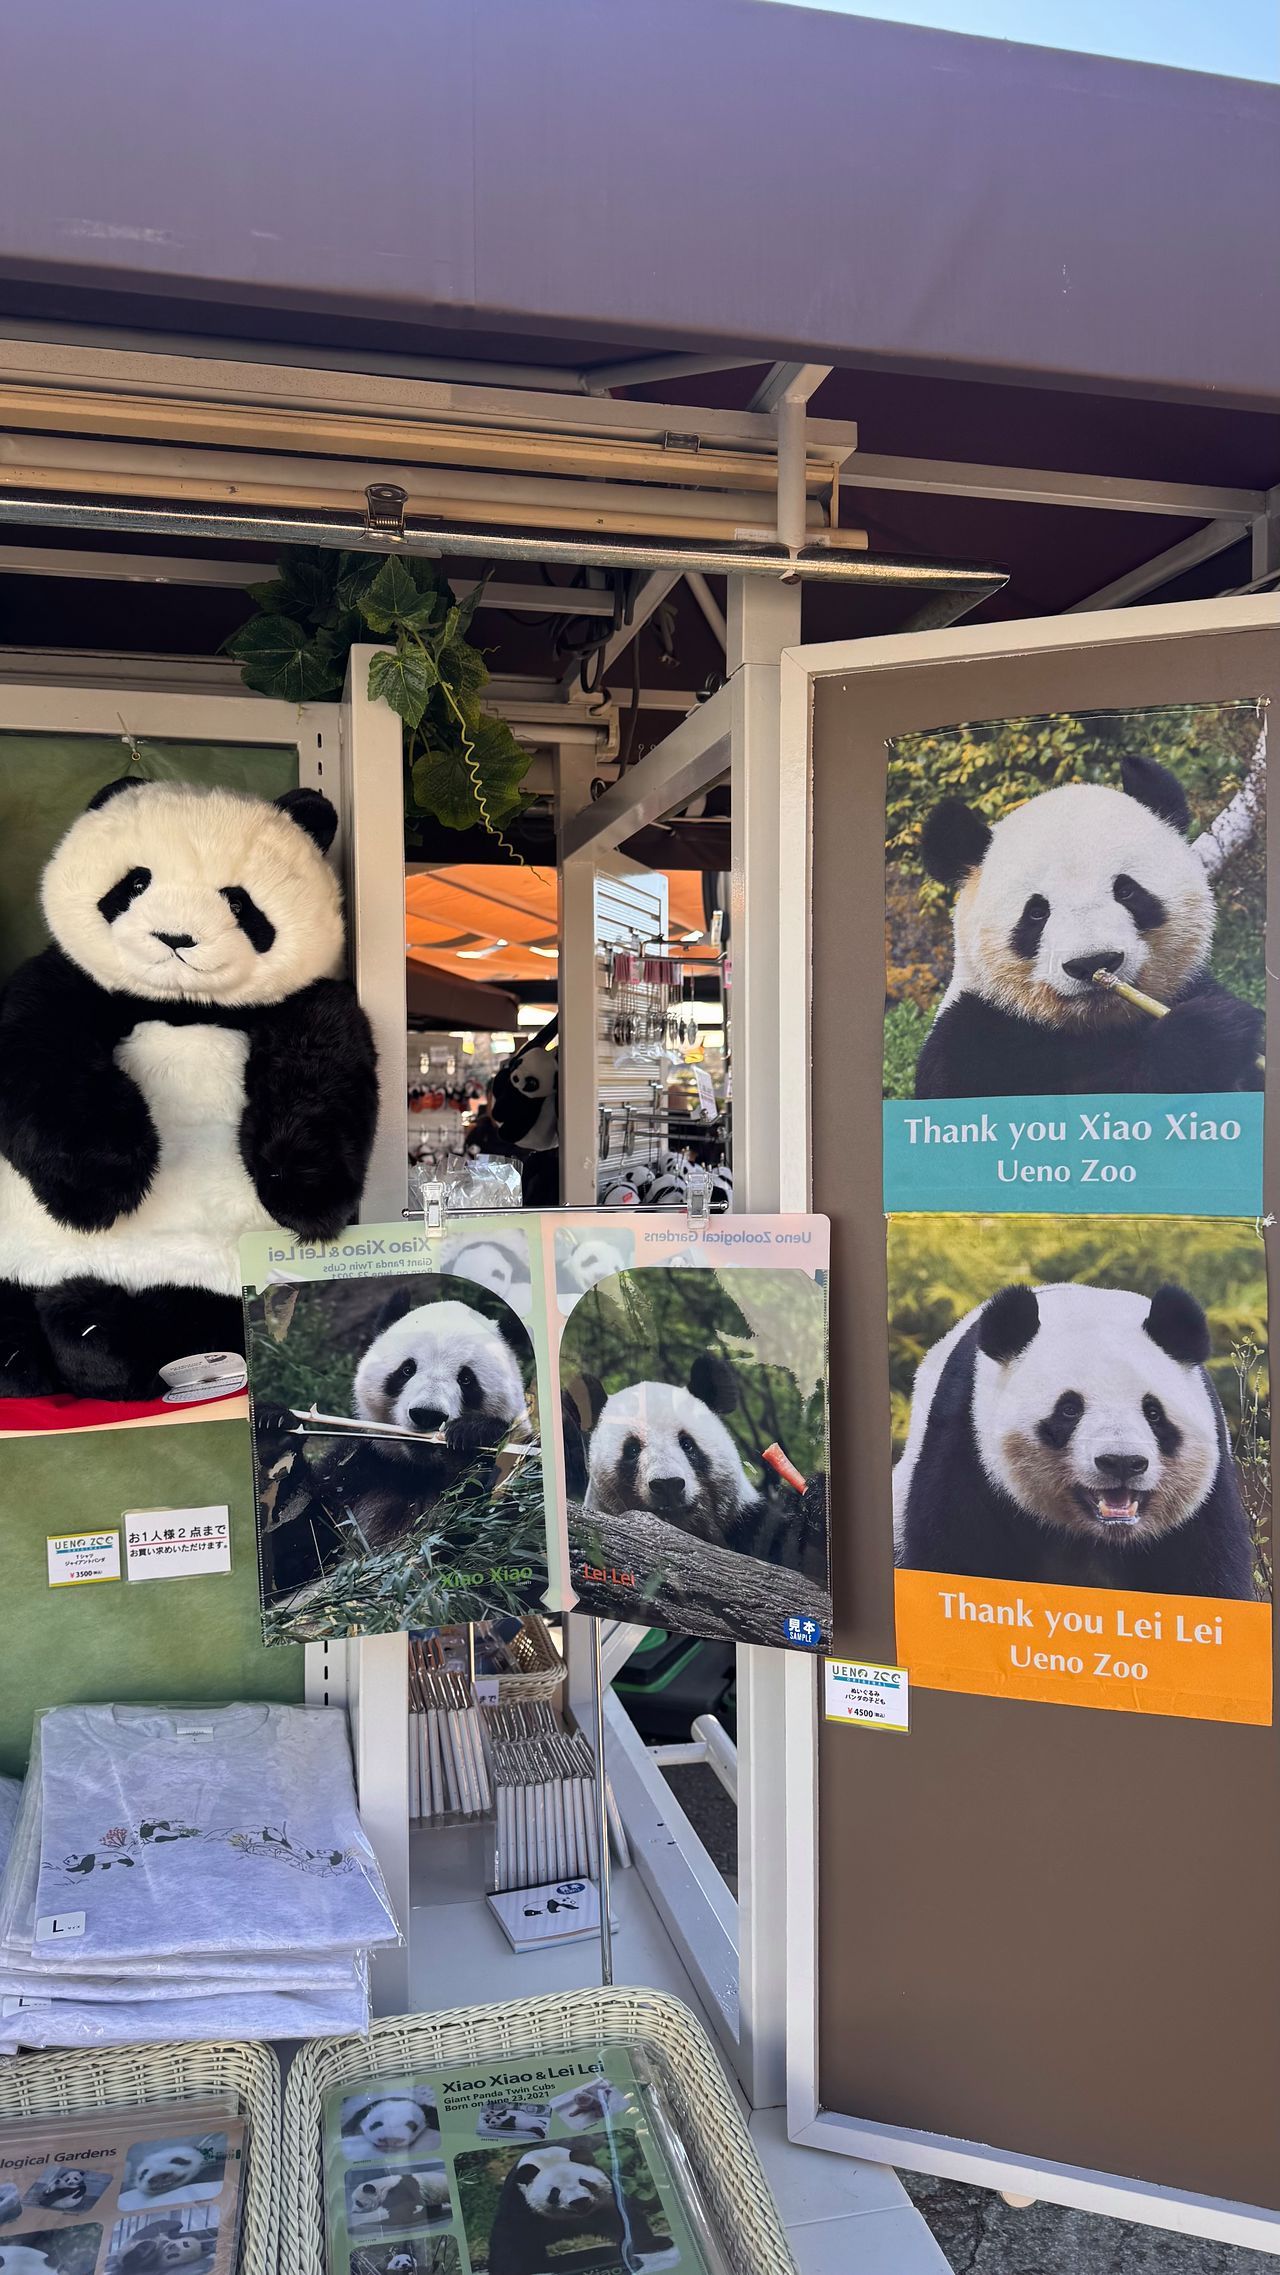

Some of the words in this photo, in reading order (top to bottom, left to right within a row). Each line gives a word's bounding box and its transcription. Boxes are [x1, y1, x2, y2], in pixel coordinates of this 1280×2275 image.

[904, 1114, 998, 1144] Thank
[1008, 1120, 1067, 1151] you
[1079, 1111, 1152, 1142] Xiao
[1164, 1111, 1241, 1142] Xiao
[997, 1159, 1071, 1183] Ueno
[1080, 1159, 1137, 1183] Zoo
[129, 1524, 226, 1543] お1人様2点まで
[55, 1539, 86, 1550] UENO
[130, 1541, 227, 1557] お買い求めいただけます。
[439, 1572, 484, 1588] Xiao
[489, 1567, 533, 1582] Xiao
[584, 1563, 607, 1583] Lei
[612, 1567, 635, 1587] Lei
[789, 1618, 816, 1634] 見本
[938, 1592, 1034, 1628] Thank
[1045, 1610, 1104, 1638] you
[1117, 1610, 1162, 1640] Lei
[1176, 1616, 1223, 1645] Lei
[790, 1632, 812, 1643] SAMPLE
[1010, 1644, 1083, 1674] Ueno
[1093, 1653, 1149, 1681] Zoo
[832, 1665, 868, 1678] UENO
[845, 1694, 886, 1705] パンダの子ども
[851, 1688, 880, 1697] ぬいぐるみ
[52, 1919, 64, 1933] L
[442, 2080, 487, 2094] Xiao
[489, 2073, 533, 2087] Xiao
[535, 2071, 547, 2081] &
[549, 2064, 575, 2079] Lei
[578, 2060, 605, 2075] Lei
[444, 2094, 471, 2105] Giant
[473, 2090, 503, 2100] Panda
[506, 2087, 530, 2096] Twin
[532, 2082, 556, 2091] Cubs
[445, 2103, 470, 2112] Born
[471, 2101, 484, 2109] on
[487, 2097, 510, 2106] June
[54, 2148, 117, 2163] Gardens
